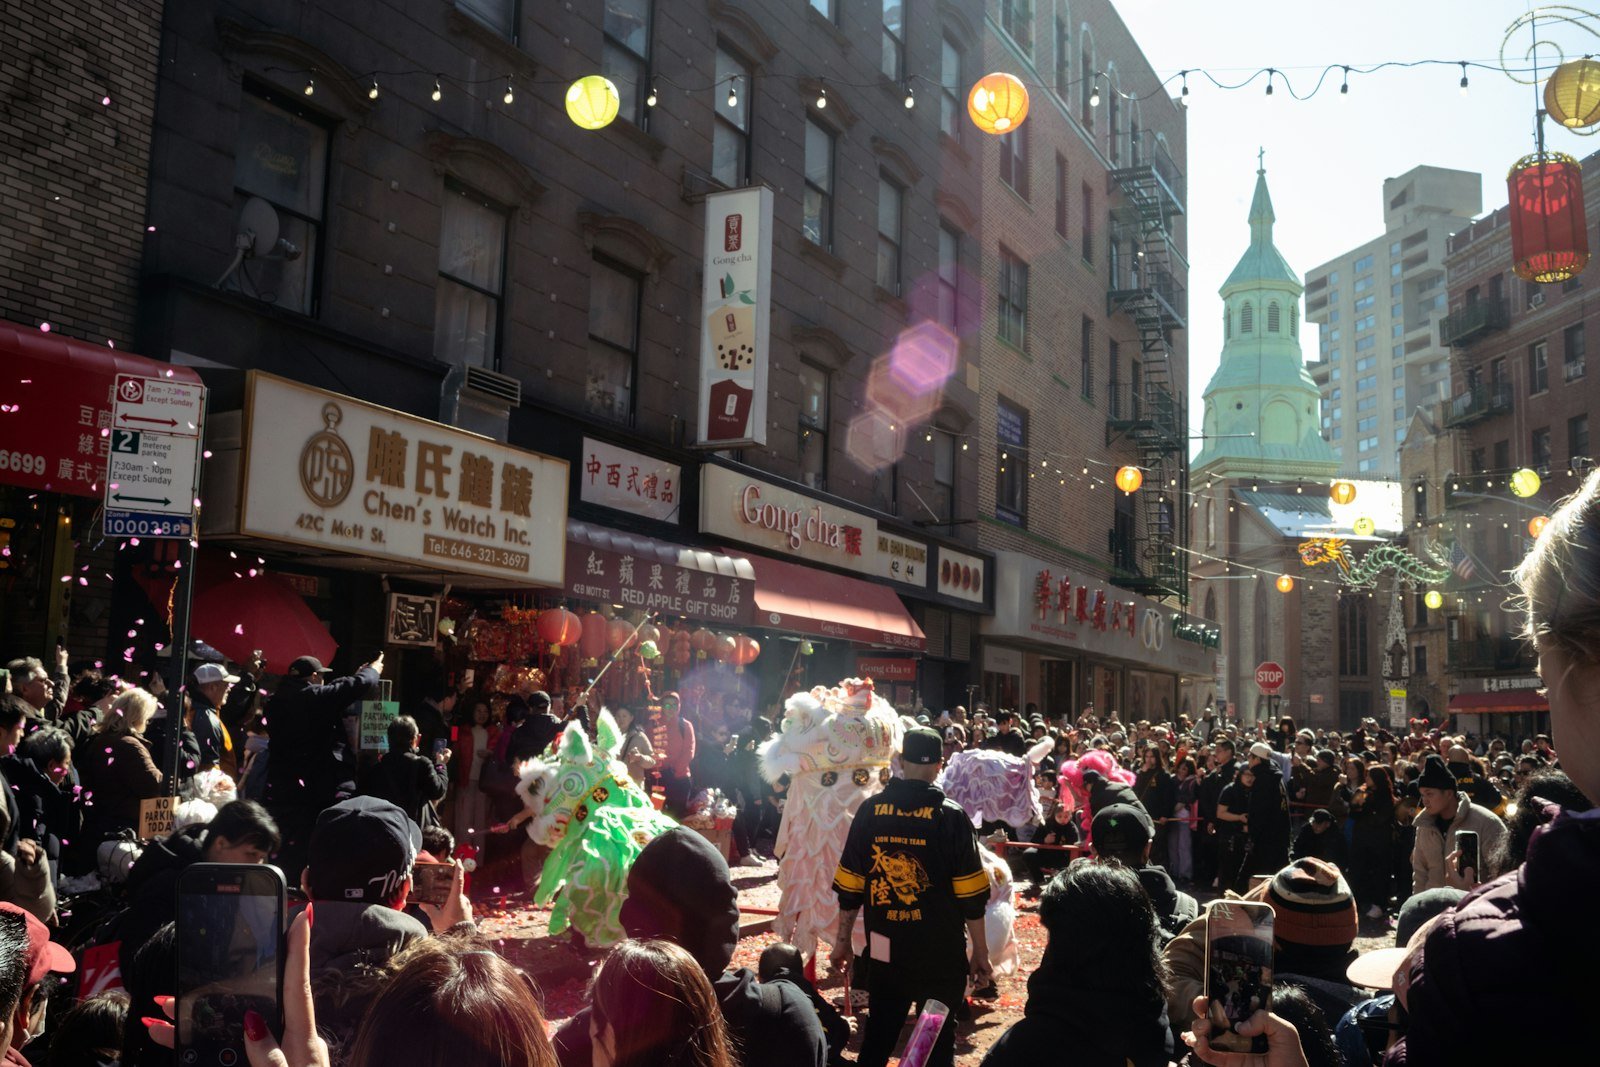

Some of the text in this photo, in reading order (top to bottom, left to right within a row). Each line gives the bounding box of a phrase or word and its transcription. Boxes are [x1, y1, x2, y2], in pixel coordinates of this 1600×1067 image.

[713, 253, 752, 265] Gong cha
[146, 395, 193, 408] Except Sunday
[118, 431, 158, 451] 2 hour
[142, 442, 171, 451] metered
[142, 450, 167, 459] parking
[114, 462, 143, 472] 7:30am
[152, 466, 172, 475] 10pm
[113, 472, 172, 485] Except Sunday
[586, 454, 674, 504] 中西式禮品
[363, 489, 532, 546] Chen's Watch Inc.
[742, 484, 802, 550] Gong
[806, 505, 841, 548] cha
[107, 520, 171, 535] 100038
[296, 513, 386, 543] 42C Mott St.
[429, 539, 528, 569] Tel: 646-321-3697
[891, 560, 914, 577] 42 44
[586, 551, 741, 604] 紅蘋果禮品店
[585, 585, 601, 597] MOTT
[621, 588, 738, 620] RED APPLE GIFT SHOP
[860, 664, 885, 674] Gong
[886, 664, 902, 674] cha
[1258, 671, 1282, 682] STOP
[156, 799, 168, 809] NO
[874, 803, 894, 816] TAI
[909, 838, 926, 846] TEAM
